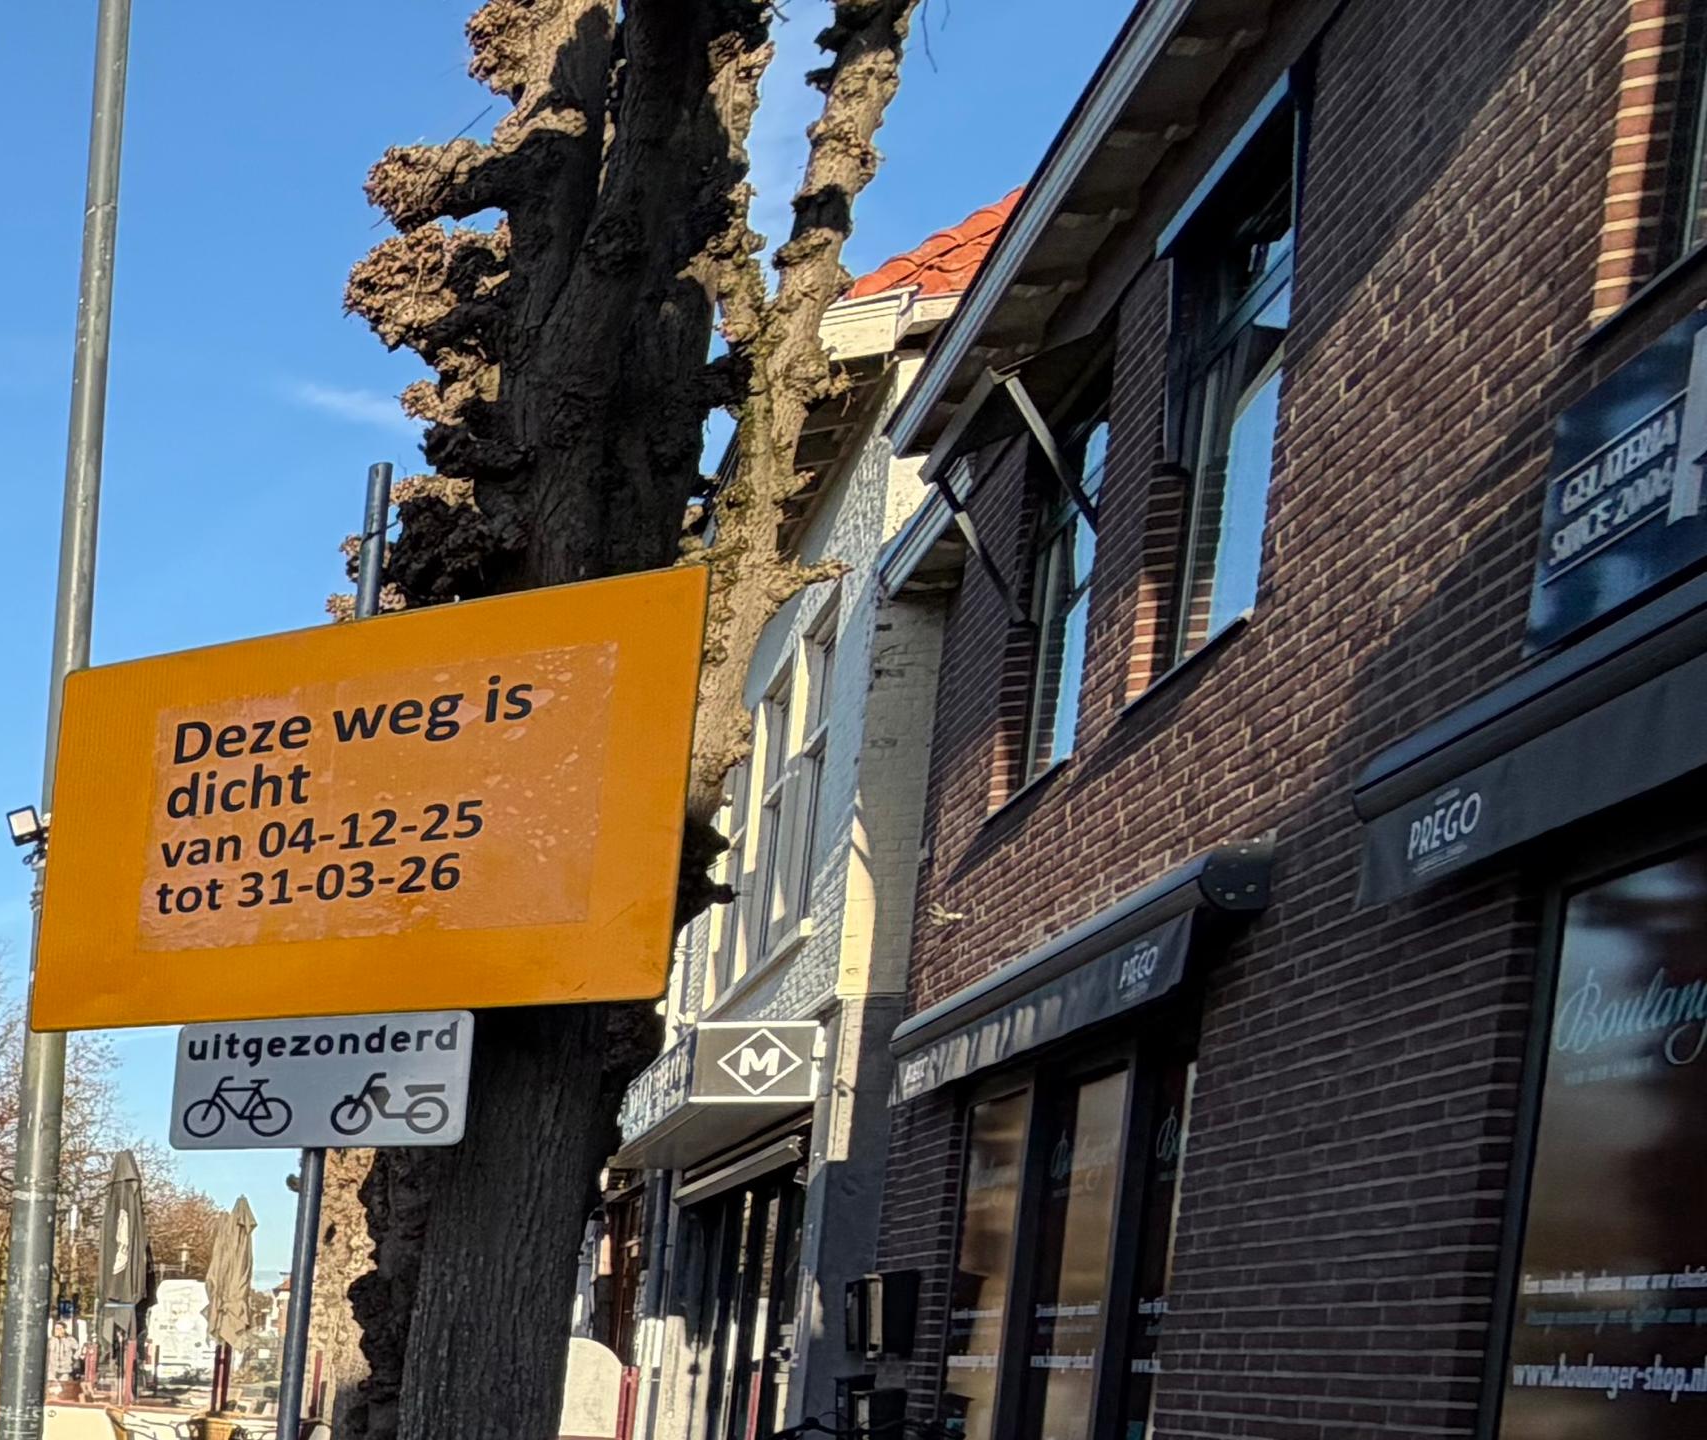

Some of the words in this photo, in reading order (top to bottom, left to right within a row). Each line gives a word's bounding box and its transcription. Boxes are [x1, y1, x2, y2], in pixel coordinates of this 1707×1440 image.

[173, 712, 313, 765] Deze
[332, 692, 465, 742] weg
[484, 675, 534, 723] is
[166, 762, 312, 820] dicht
[160, 832, 242, 868] van
[258, 799, 484, 858] 04-12-25
[1407, 791, 1482, 861] PREGO
[156, 877, 224, 915] tot
[237, 852, 461, 908] 31-03-26
[187, 1019, 460, 1068] uitgezonderd
[738, 1047, 780, 1077] M
